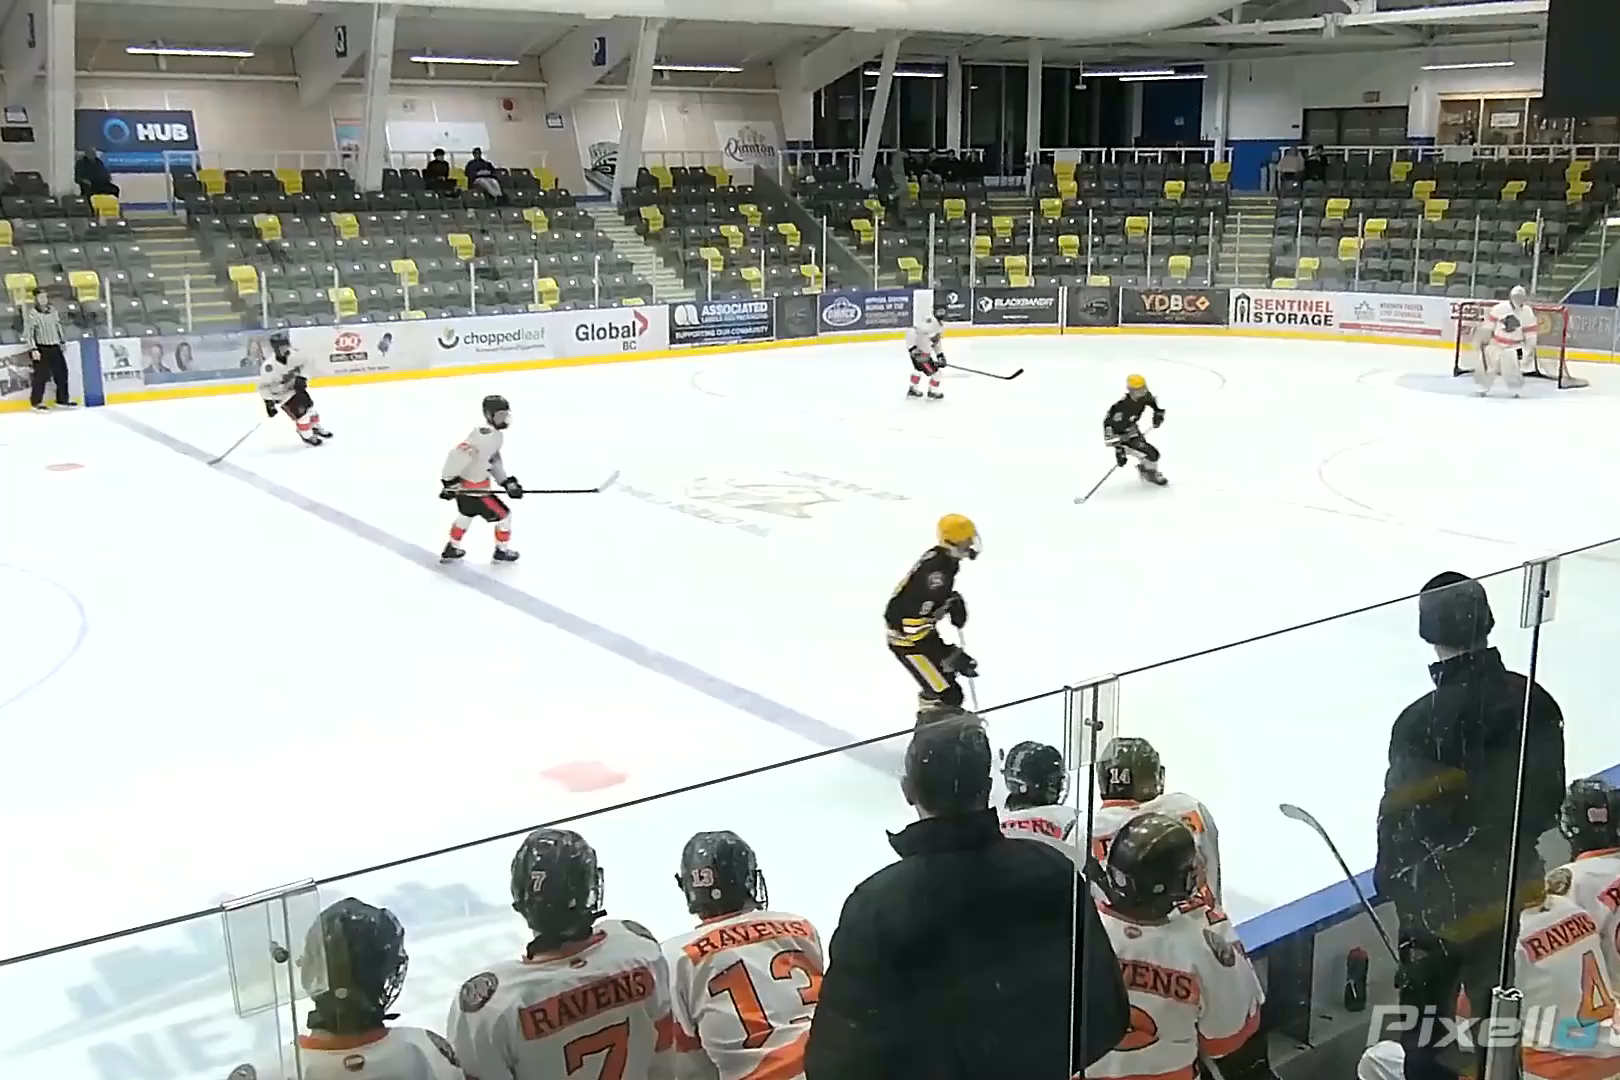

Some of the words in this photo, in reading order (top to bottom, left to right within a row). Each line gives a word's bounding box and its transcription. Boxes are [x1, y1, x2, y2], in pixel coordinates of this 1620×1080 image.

[136, 123, 189, 141] HUB
[702, 301, 768, 316] ASSOCIATED
[1141, 294, 1197, 311] YDBC
[1254, 298, 1333, 313] SENTINEL
[1253, 311, 1334, 327] STORAGE
[575, 320, 636, 341] Global
[622, 341, 637, 351] BC
[1109, 768, 1131, 785] 14
[531, 871, 547, 892] 7
[691, 868, 715, 887] 13
[696, 920, 808, 957] RAVENS
[1525, 914, 1597, 959] RAVENS
[529, 971, 647, 1036] RAVENS
[563, 1016, 631, 1080] 7
